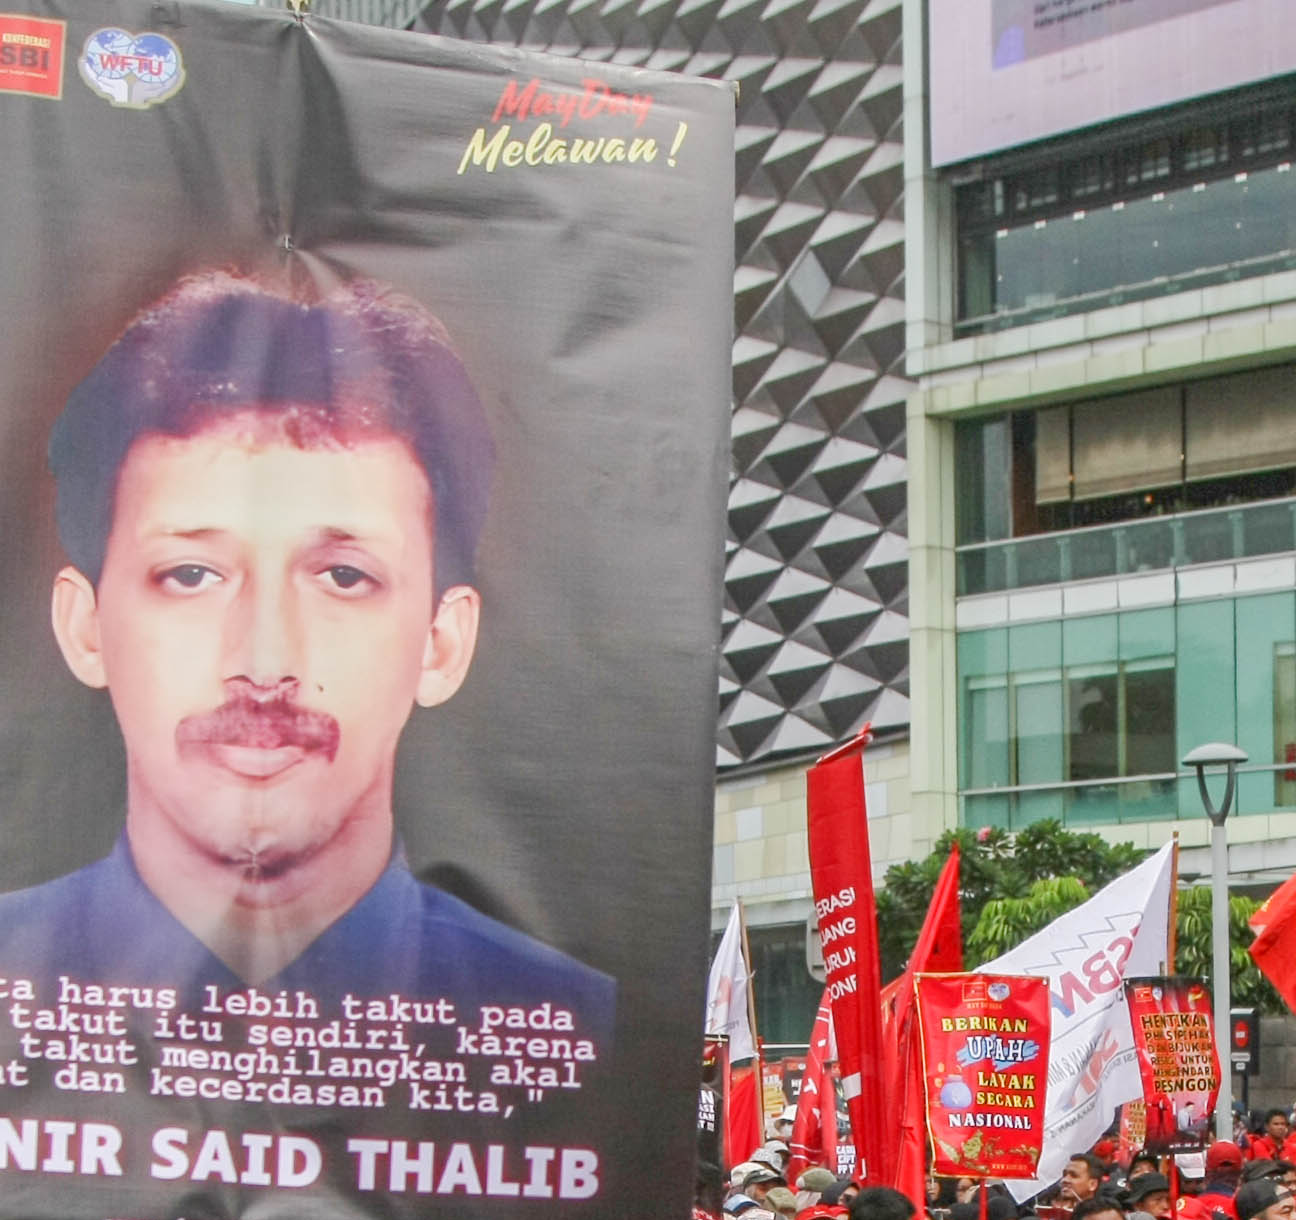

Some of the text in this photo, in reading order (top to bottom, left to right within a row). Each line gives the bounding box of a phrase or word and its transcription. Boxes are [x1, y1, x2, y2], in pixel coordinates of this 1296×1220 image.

[99, 54, 163, 76] WFTU
[58, 976, 177, 1010] harus
[202, 985, 319, 1019] lebih
[342, 994, 457, 1025] takut
[480, 1002, 575, 1034] pada
[9, 1003, 128, 1036] takut
[154, 1011, 223, 1042] itu
[248, 1021, 426, 1057] sendiri,
[456, 1027, 597, 1062] karena
[941, 1016, 1028, 1034] BERIKAN
[20, 1031, 139, 1066] takut
[161, 1046, 467, 1087] menghilangkan
[490, 1058, 582, 1089] akal
[966, 1035, 1024, 1061] UPAH
[54, 1063, 126, 1094] dan
[150, 1068, 386, 1109] kecerdasan
[409, 1083, 544, 1120] kita,"
[977, 1071, 1035, 1090] LAYAK
[976, 1092, 1035, 1108] SECARA
[948, 1114, 1032, 1130] NASIONAL
[150, 1127, 322, 1188] SAID
[347, 1137, 601, 1200] THALIB
